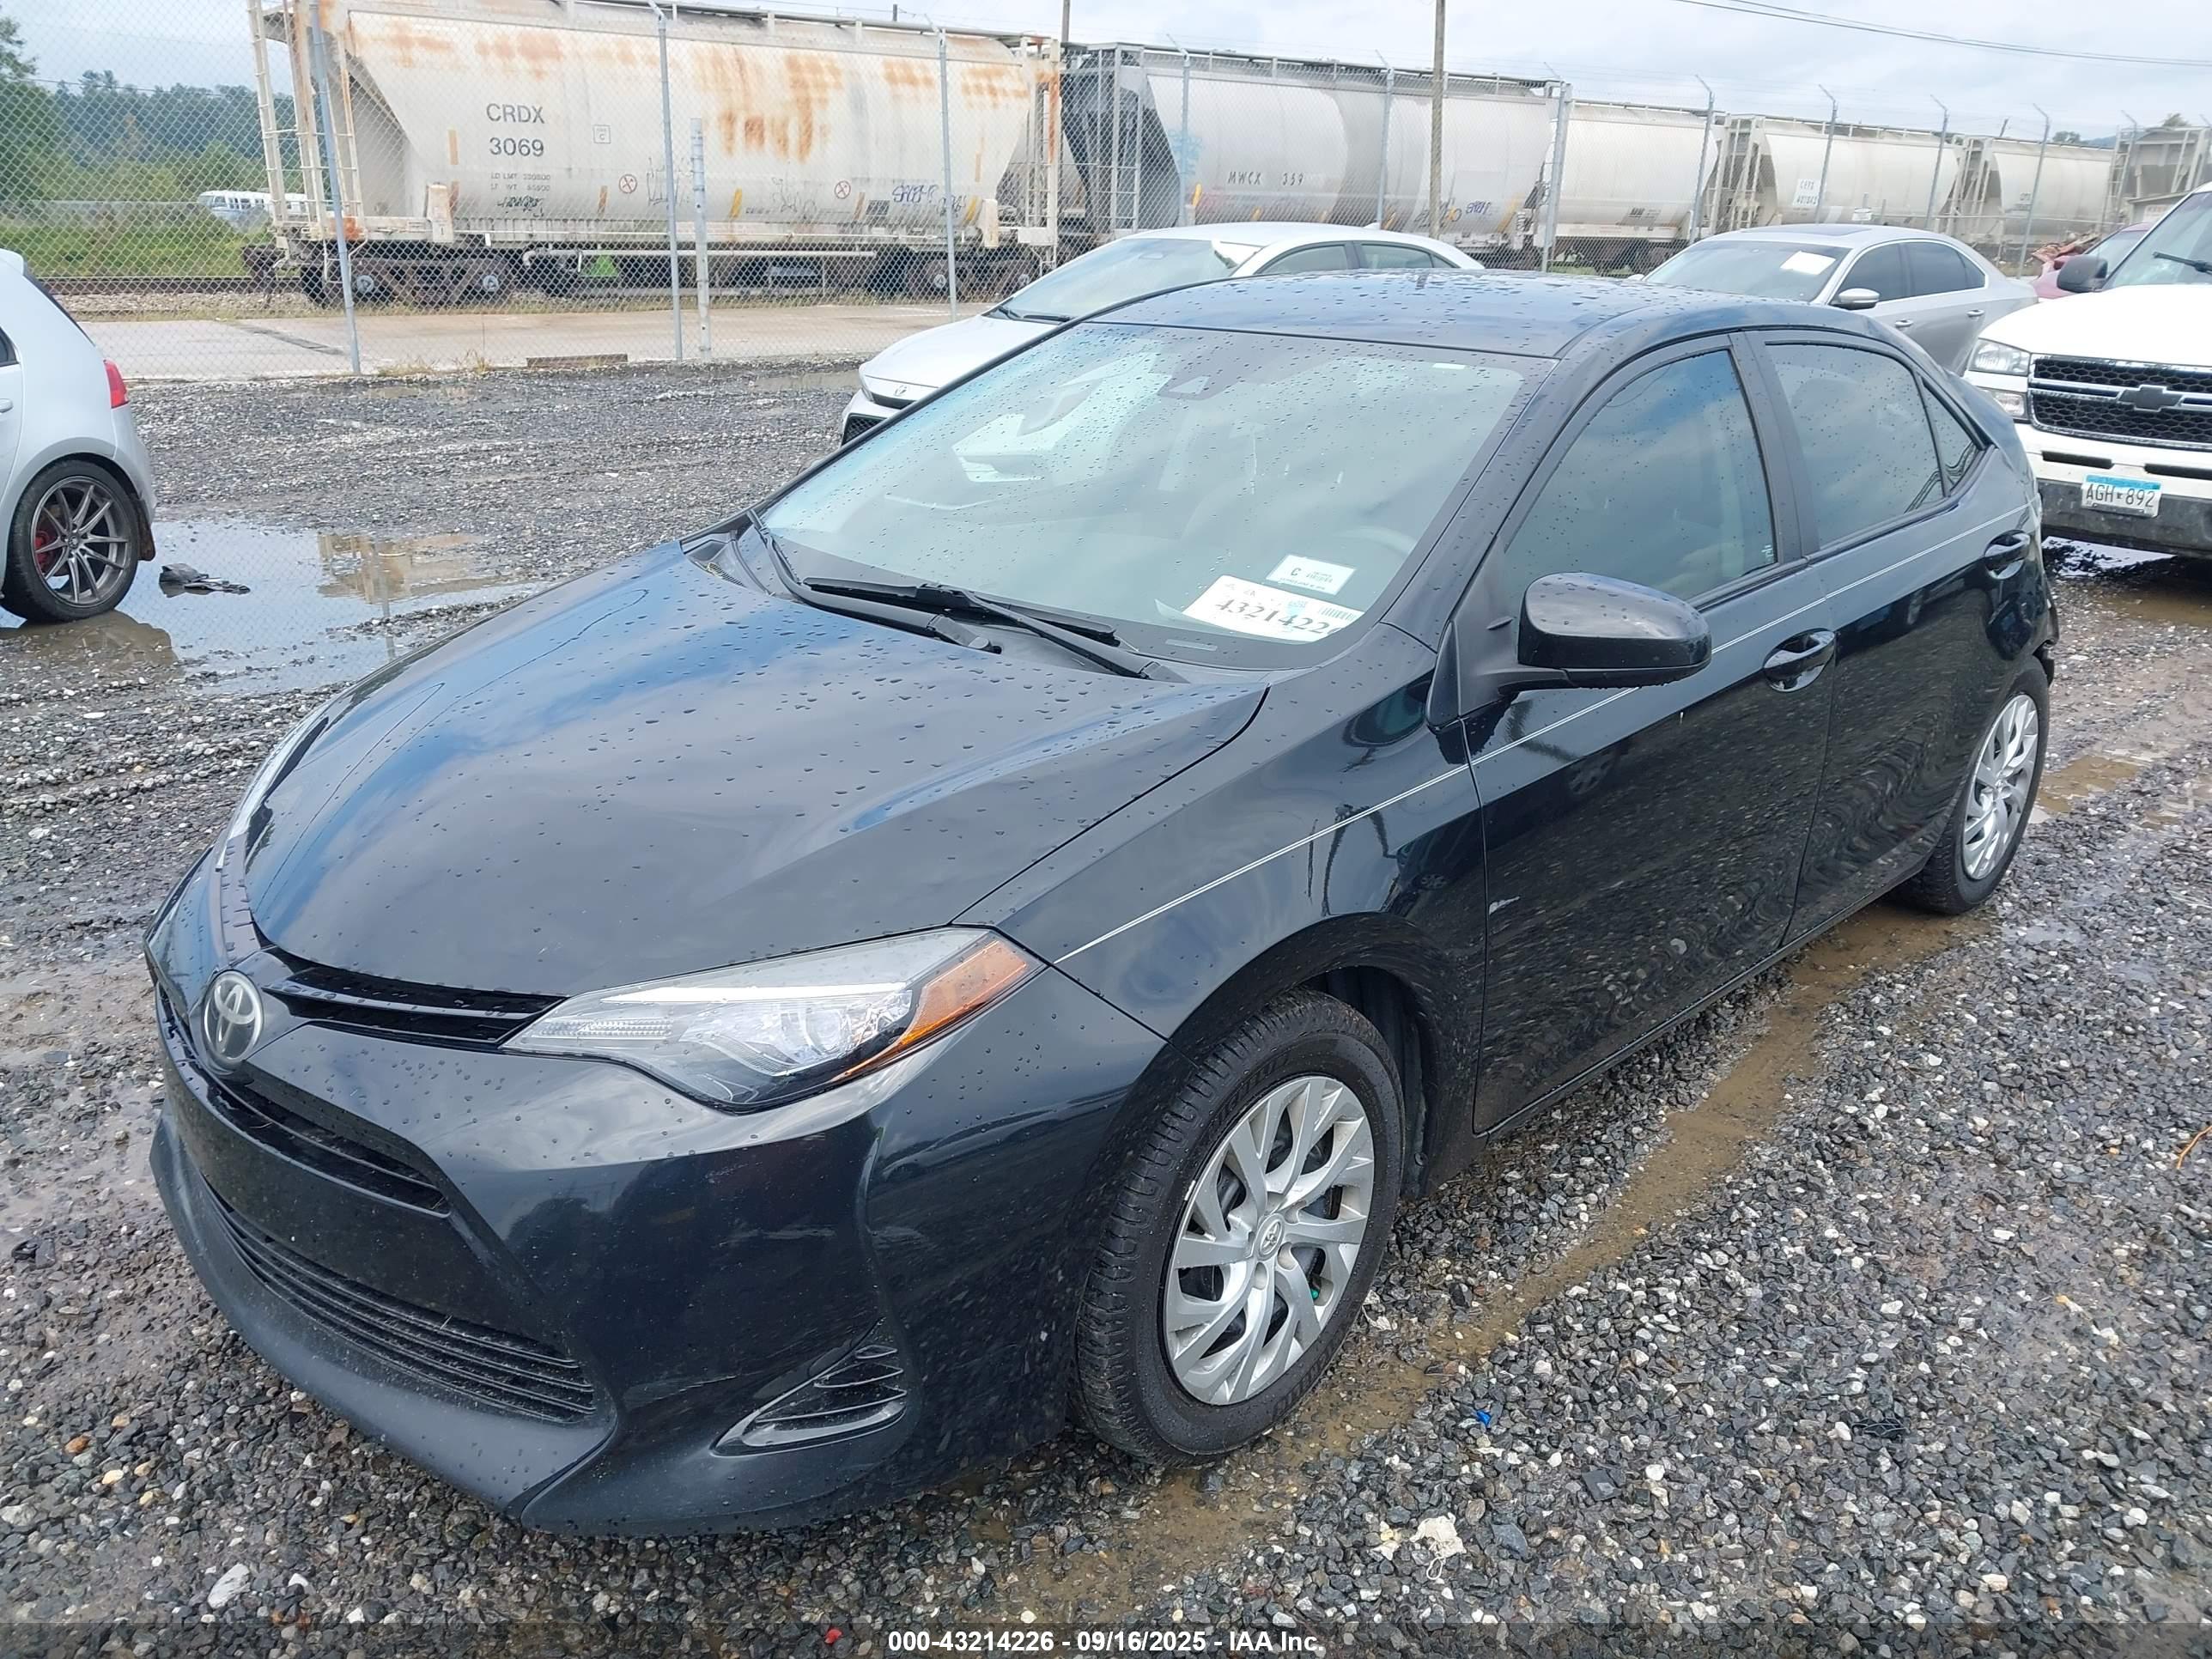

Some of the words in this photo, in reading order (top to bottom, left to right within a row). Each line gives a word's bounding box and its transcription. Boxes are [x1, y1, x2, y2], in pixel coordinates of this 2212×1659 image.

[486, 103, 545, 124] CRDX
[489, 137, 544, 157] 3069
[1228, 172, 1261, 185] MWCX
[2086, 483, 2115, 502] AGH
[2125, 488, 2155, 508] 892
